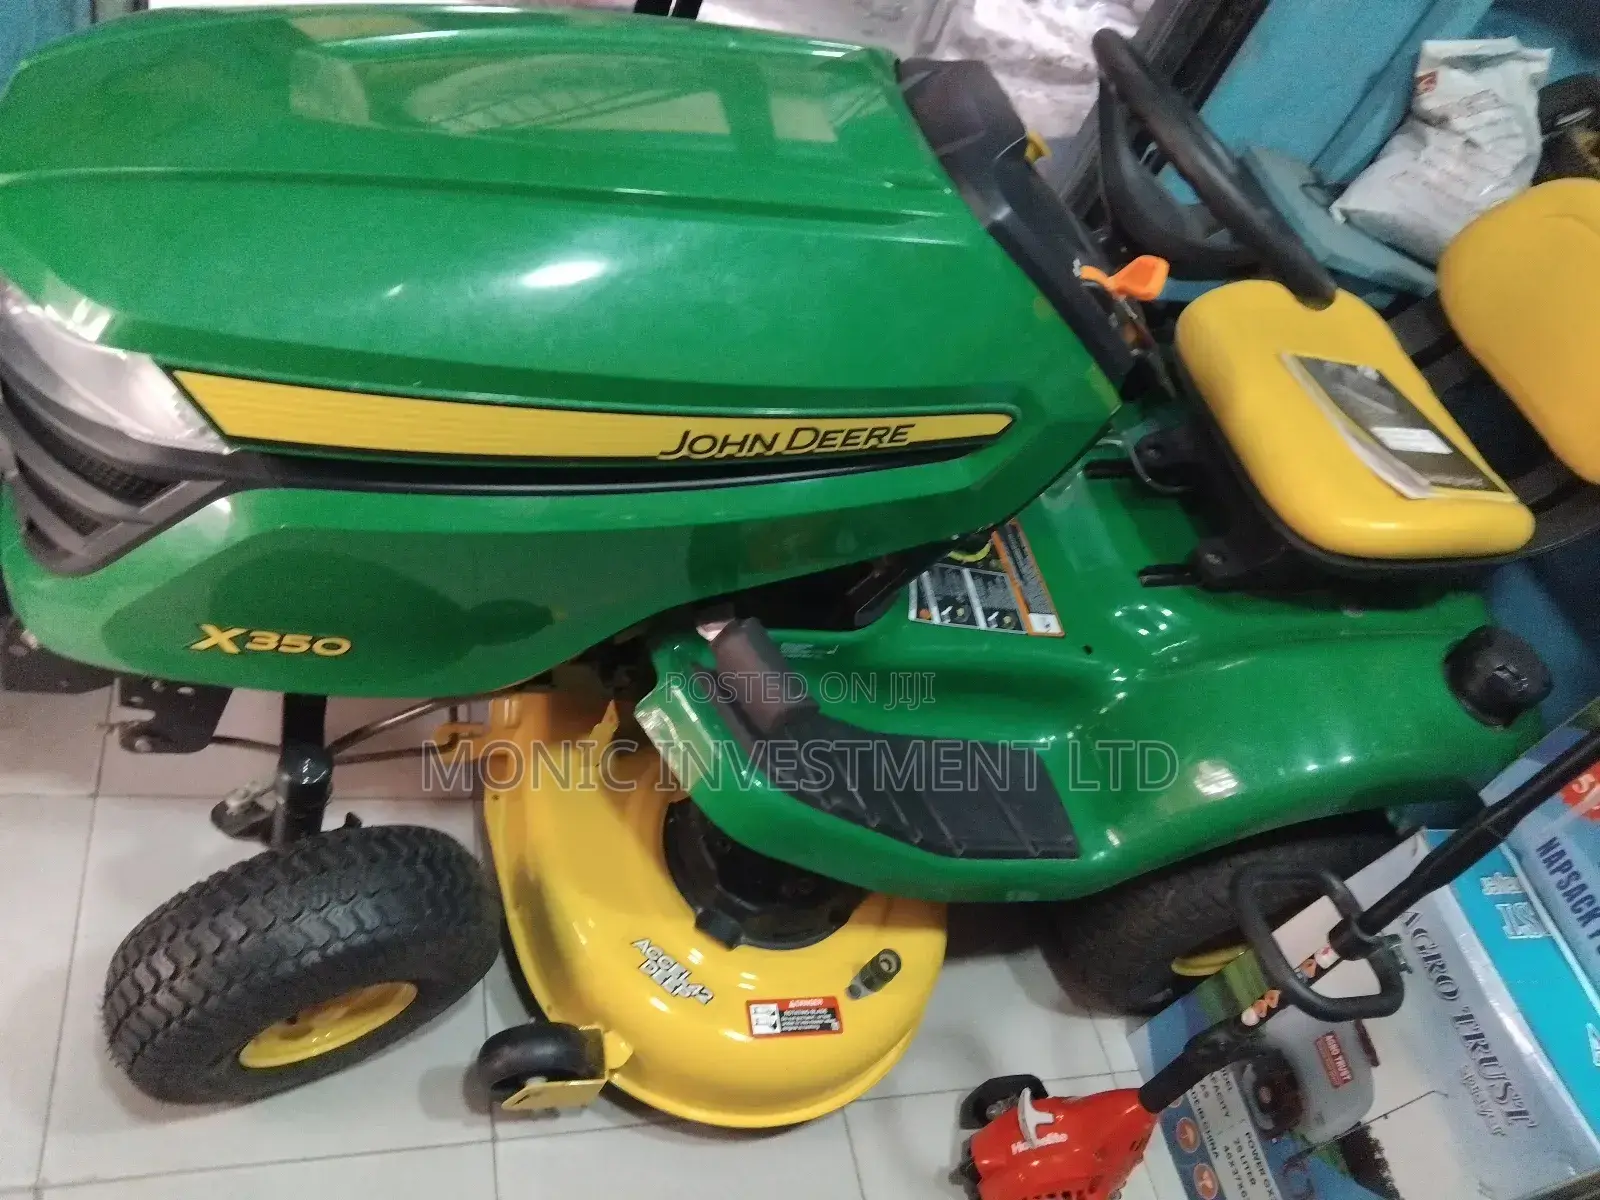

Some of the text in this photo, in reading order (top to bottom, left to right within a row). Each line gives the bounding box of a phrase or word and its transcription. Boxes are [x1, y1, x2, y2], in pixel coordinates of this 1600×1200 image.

[659, 424, 915, 458] JOHN DEERE
[190, 623, 351, 656] X350
[1401, 911, 1460, 1001] AGRO
[1452, 1006, 1536, 1128] TRUST
